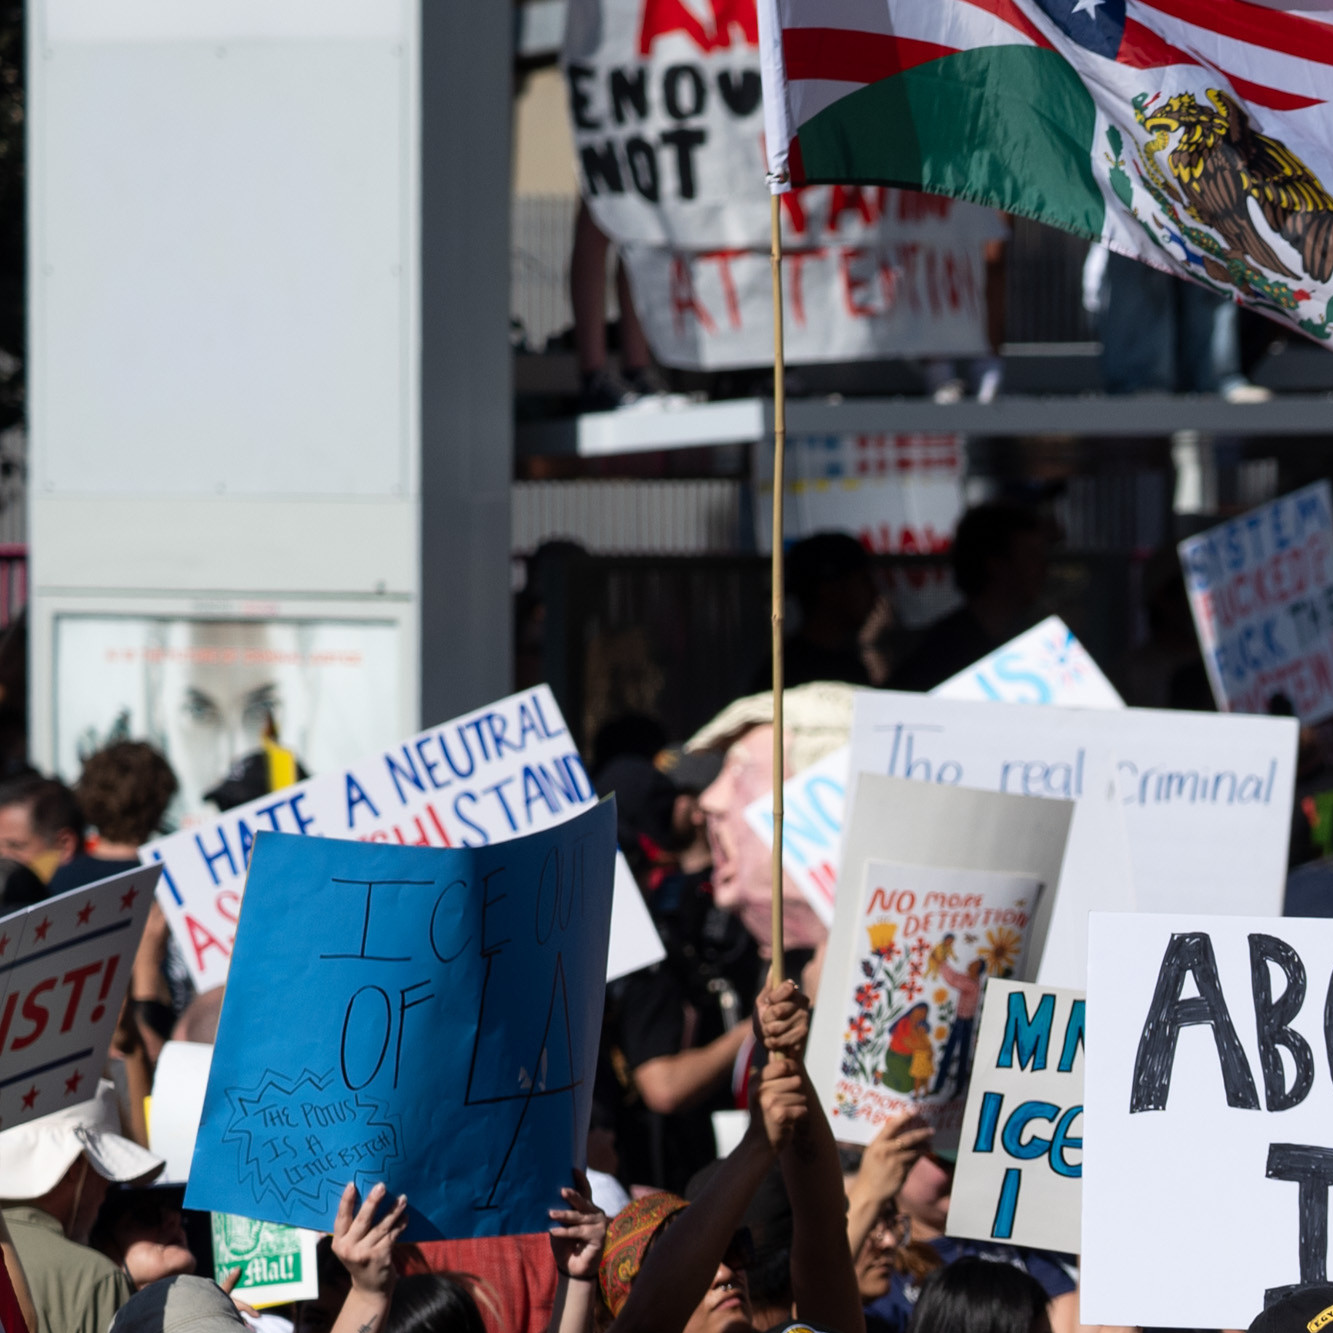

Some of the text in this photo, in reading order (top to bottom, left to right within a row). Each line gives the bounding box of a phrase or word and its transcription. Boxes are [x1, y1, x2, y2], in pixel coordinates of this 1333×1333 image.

[567, 63, 763, 130] ENOU
[581, 128, 705, 202] NOT
[872, 721, 964, 785] The
[1001, 746, 1086, 800] real
[152, 852, 186, 906] I
[195, 794, 319, 886] HATE
[345, 772, 380, 829] A
[384, 694, 568, 796] NEUTRAL
[452, 753, 598, 848] STAND
[320, 832, 596, 963] ICE OUT
[866, 886, 917, 916] NO
[903, 908, 1030, 938] DETENTION
[341, 979, 435, 1090] OF
[253, 1100, 357, 1128] THE POTUS
[262, 1133, 325, 1163] IS A
[284, 1130, 392, 1186] LITTLE BITCH
[243, 1255, 295, 1286] Mal!
